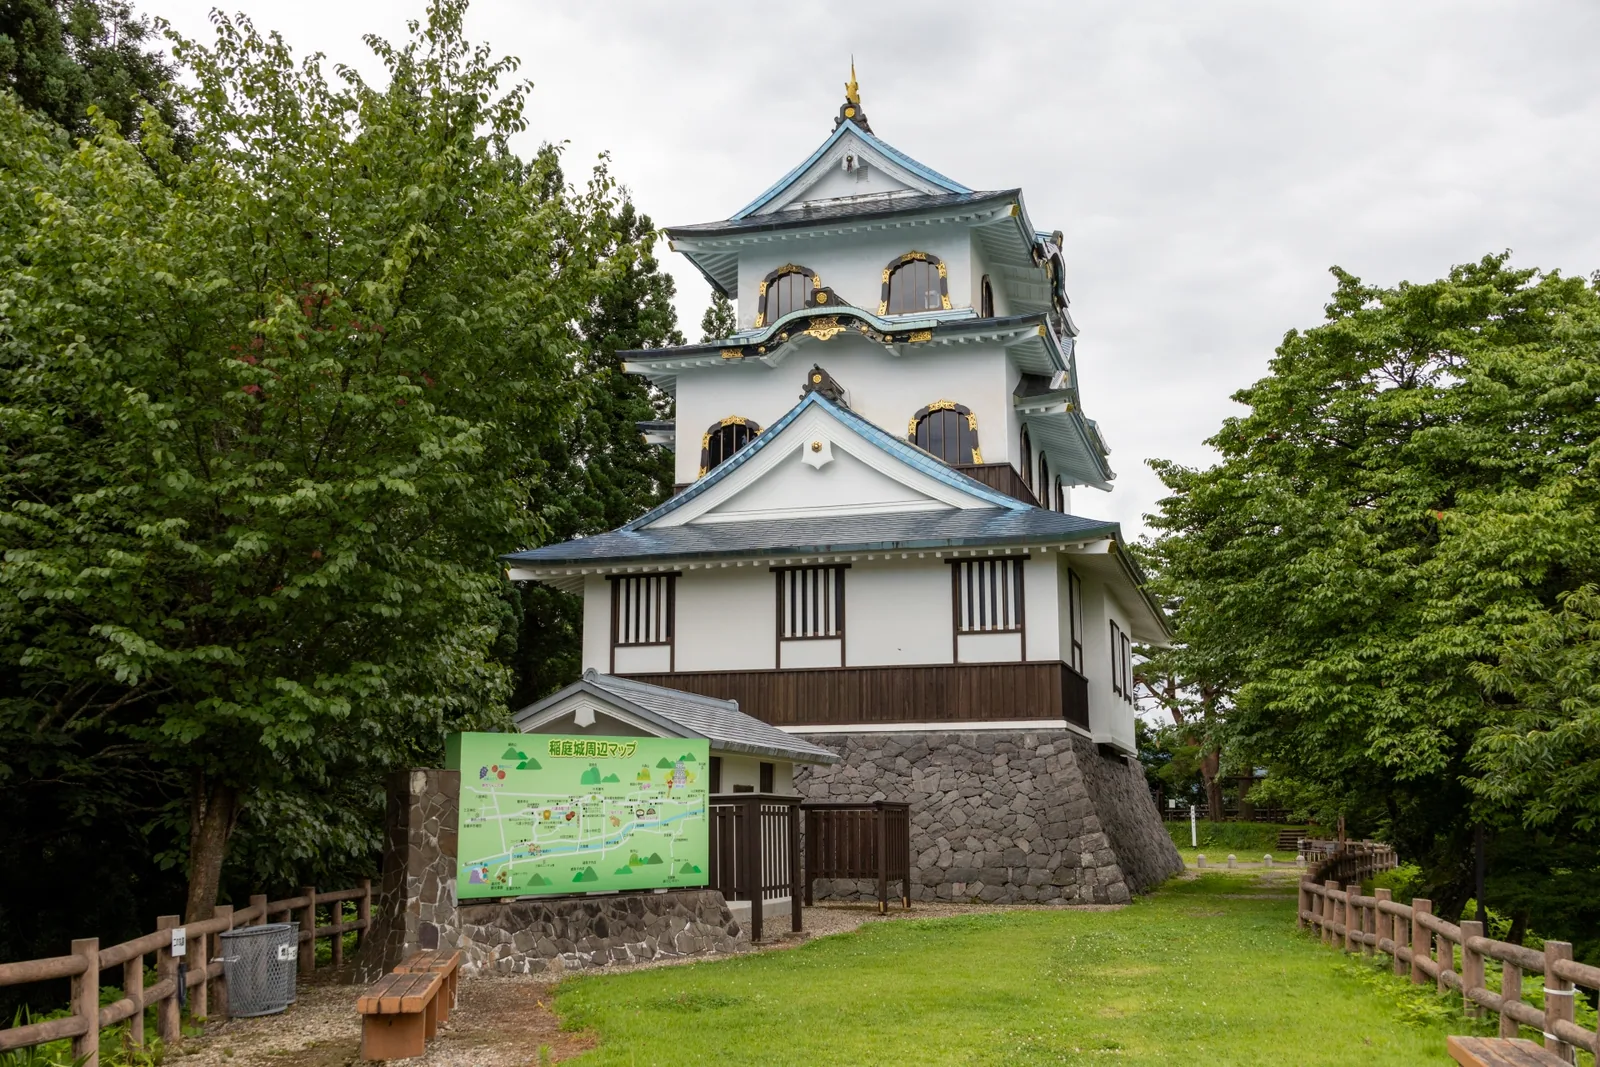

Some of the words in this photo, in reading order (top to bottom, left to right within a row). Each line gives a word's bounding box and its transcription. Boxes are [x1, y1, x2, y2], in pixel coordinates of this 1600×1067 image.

[548, 740, 637, 757] 稲庭城周辺マップ
